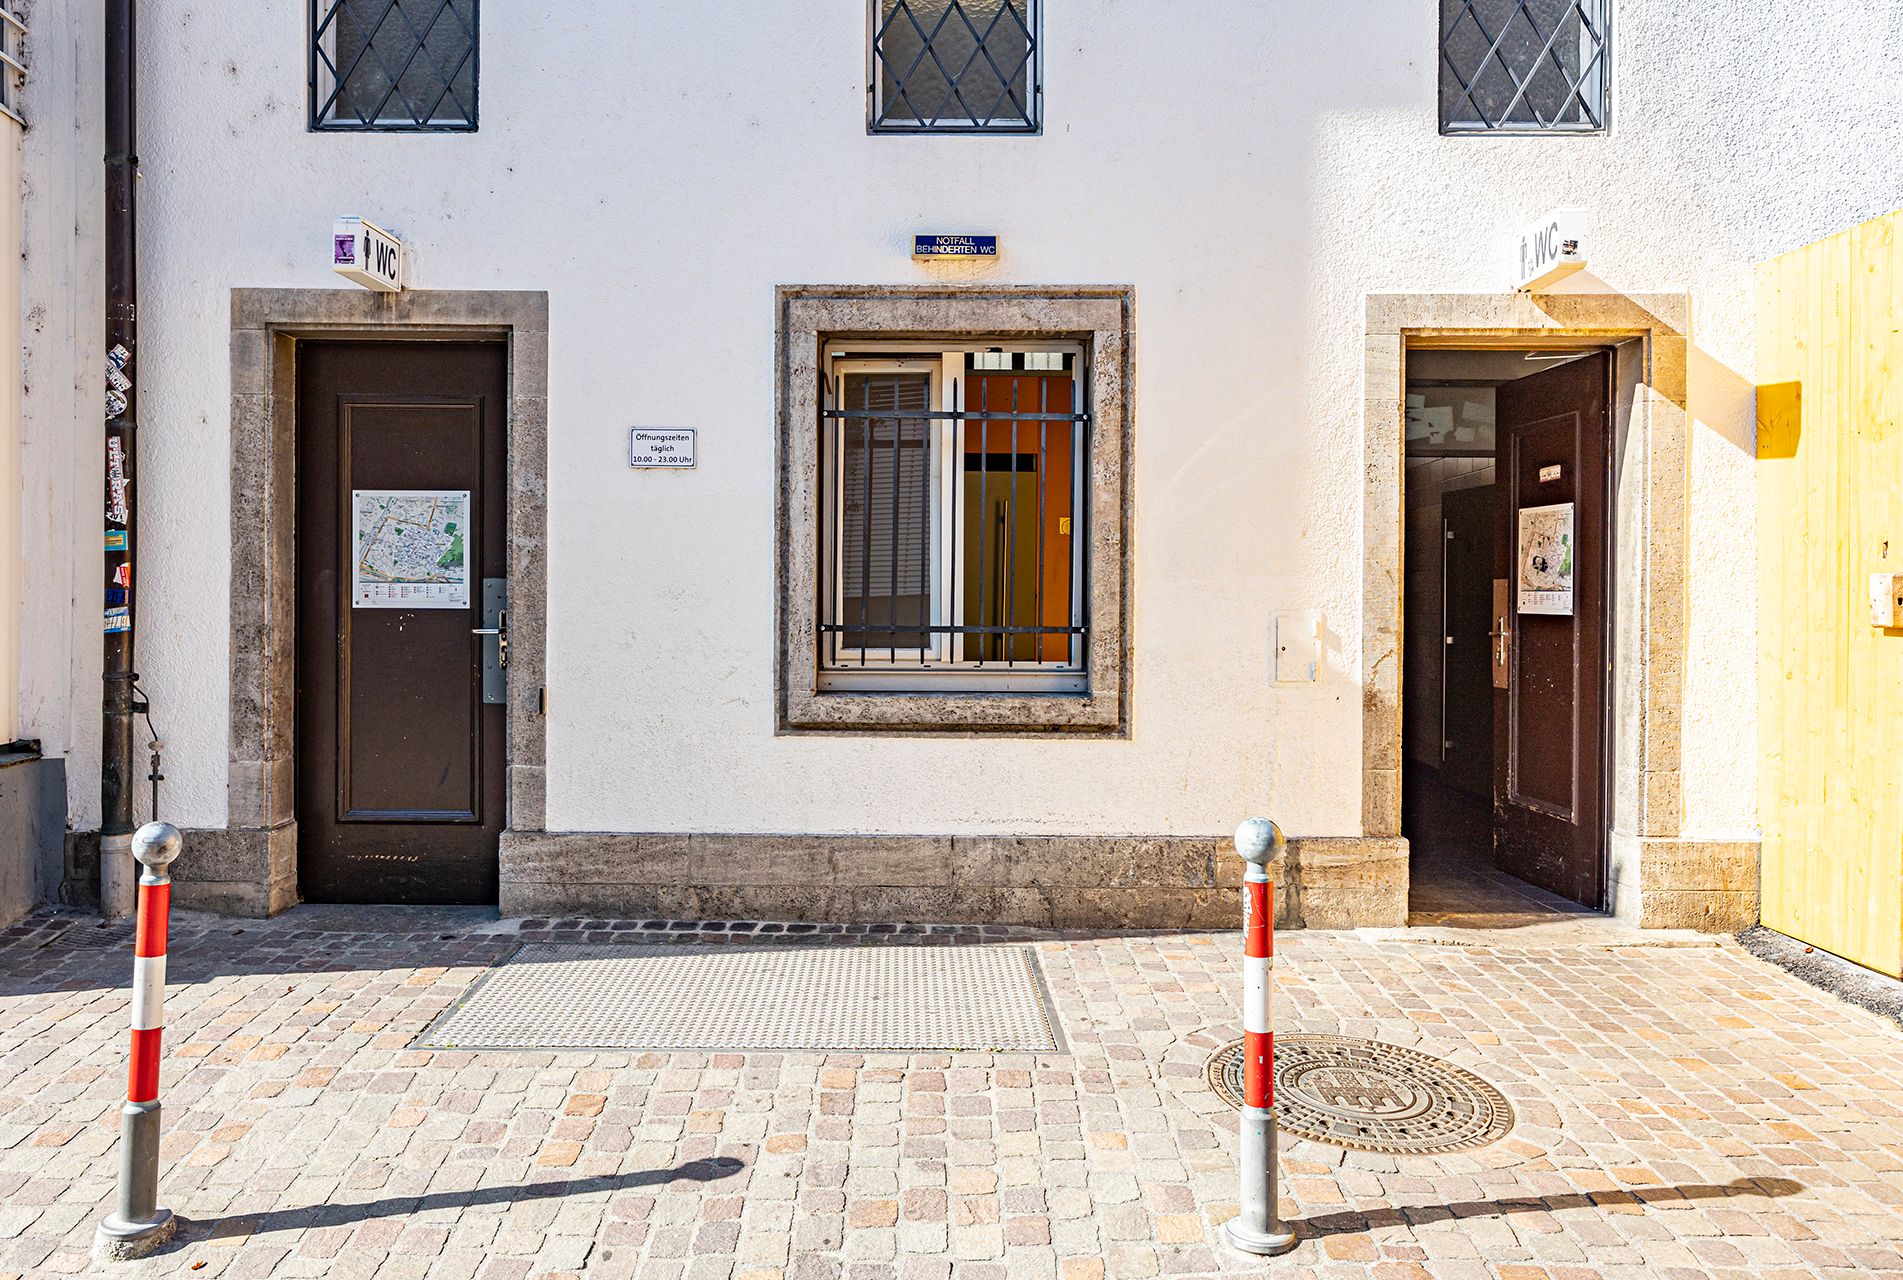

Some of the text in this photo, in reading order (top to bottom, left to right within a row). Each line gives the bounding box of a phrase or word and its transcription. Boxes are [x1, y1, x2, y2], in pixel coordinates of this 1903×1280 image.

[936, 236, 975, 246] NOTFALL
[1534, 221, 1558, 268] WC
[916, 245, 995, 254] BEHINDERTEN WC
[376, 238, 397, 281] WC
[635, 432, 690, 443] Öffnungszeiten
[650, 445, 675, 454] täglich
